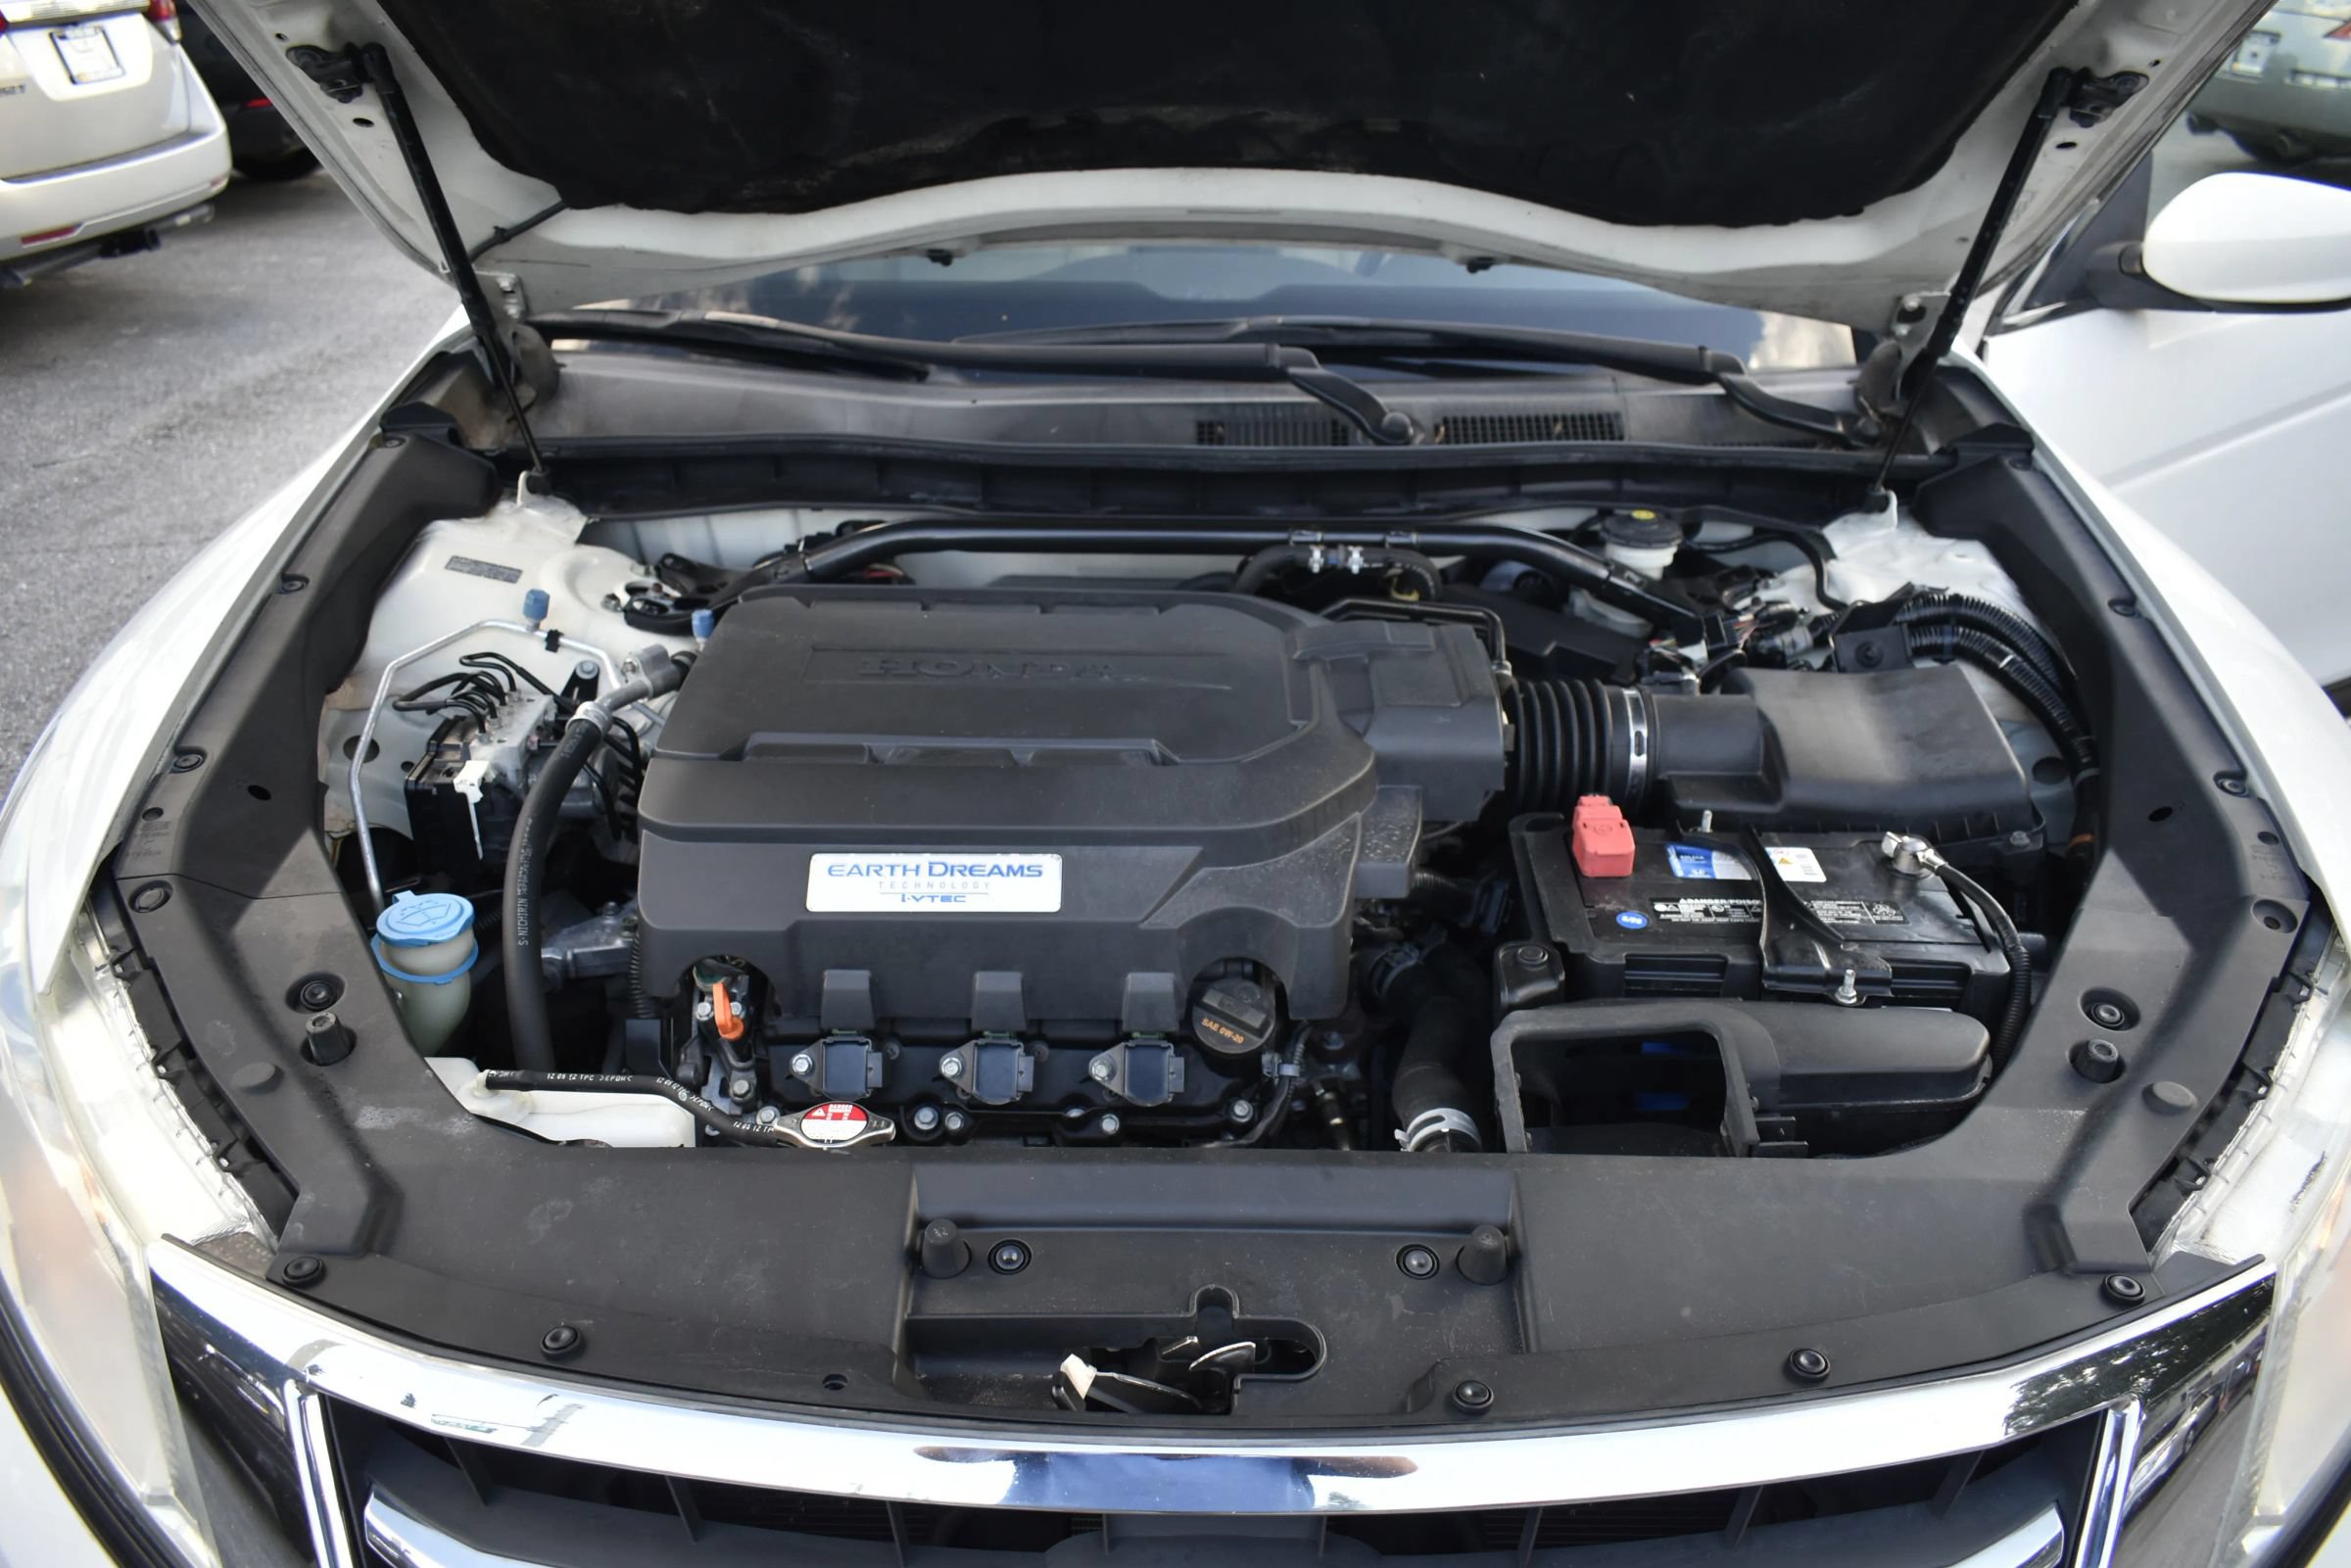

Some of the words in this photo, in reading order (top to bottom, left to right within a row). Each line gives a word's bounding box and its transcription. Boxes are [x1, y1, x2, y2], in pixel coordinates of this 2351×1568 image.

[858, 657, 1116, 681] HONDA
[827, 863, 922, 878] EARTH
[928, 861, 1043, 878] DREAMS
[878, 880, 991, 889] TECHNOLOGY
[1201, 1018, 1221, 1032] SAE
[1219, 1025, 1245, 1044] 0W-20
